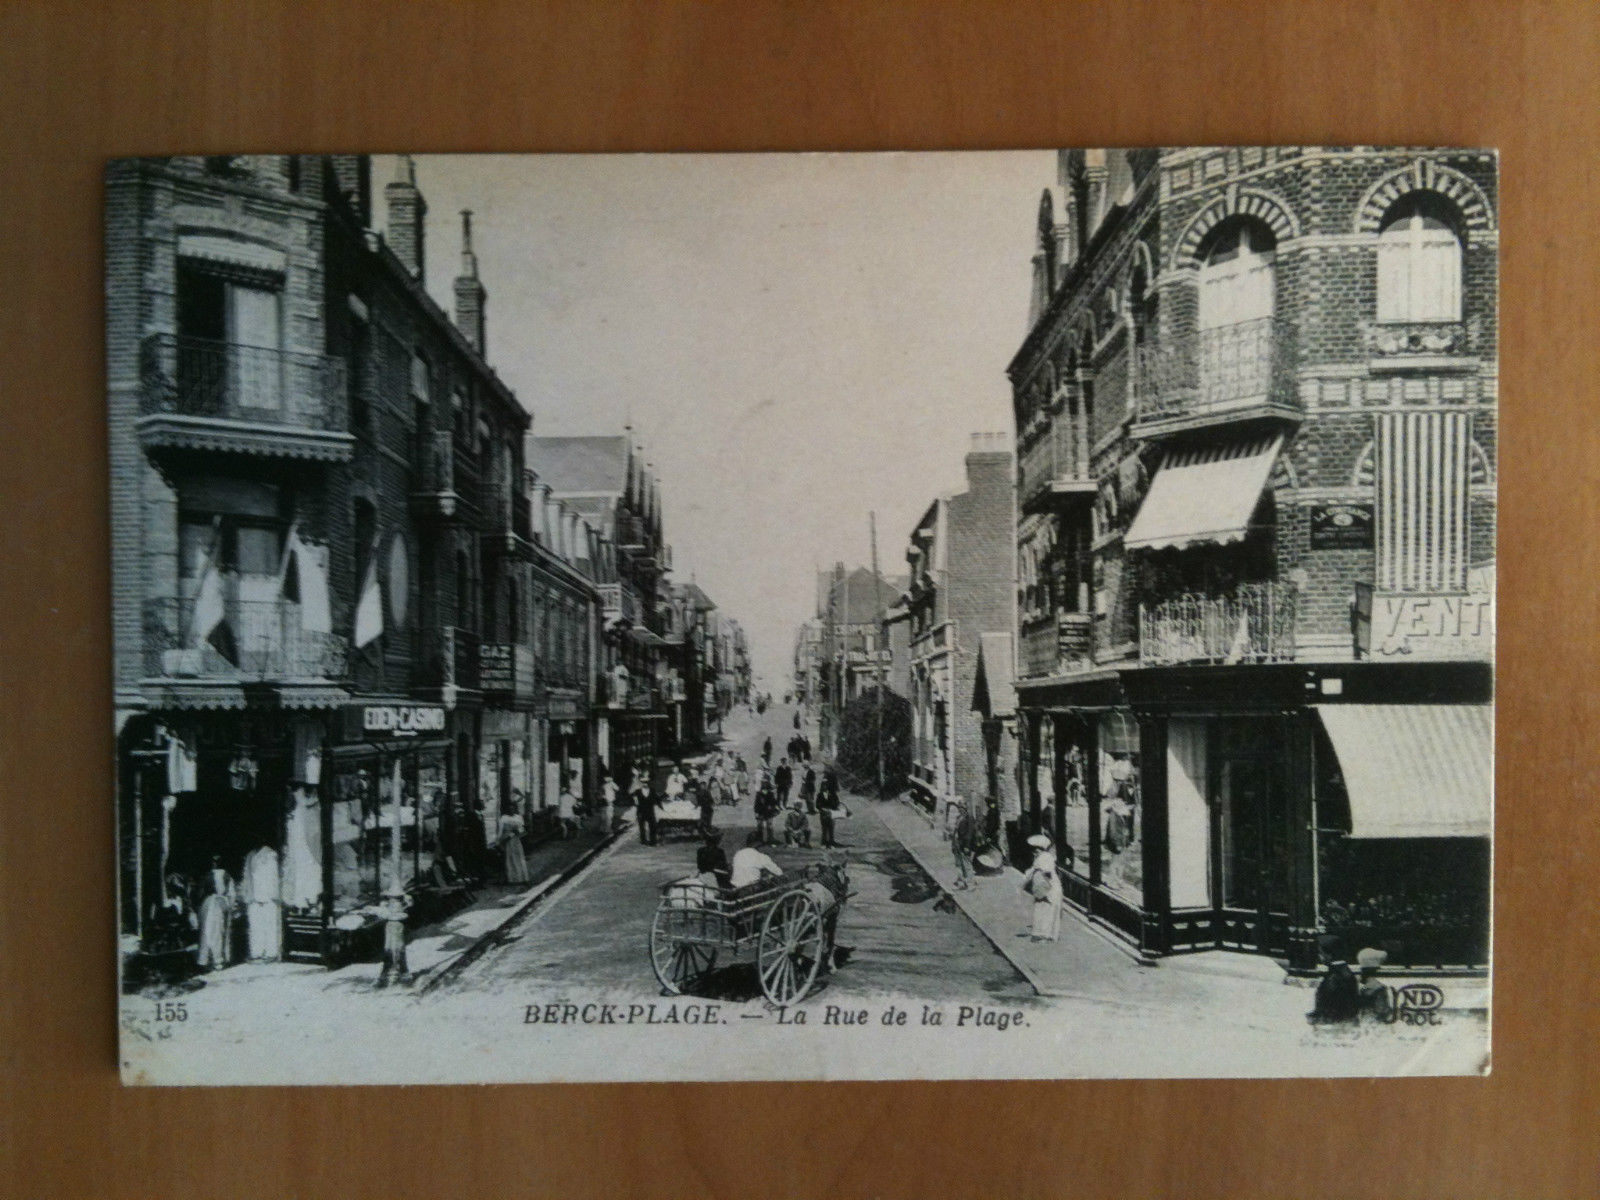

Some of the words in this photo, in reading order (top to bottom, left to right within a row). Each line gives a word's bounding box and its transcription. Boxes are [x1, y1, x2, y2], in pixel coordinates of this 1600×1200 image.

[478, 644, 511, 658] GAZ
[364, 706, 445, 731] EDEN-CASINO
[1402, 989, 1437, 1007] ND
[154, 1002, 189, 1023] 155
[524, 1004, 728, 1025] BERCK-PLAGE.
[778, 1006, 807, 1026] La
[824, 1006, 869, 1028] Rue
[881, 1005, 908, 1027] de
[922, 1006, 944, 1028] la
[957, 1007, 1032, 1031] Plage.
